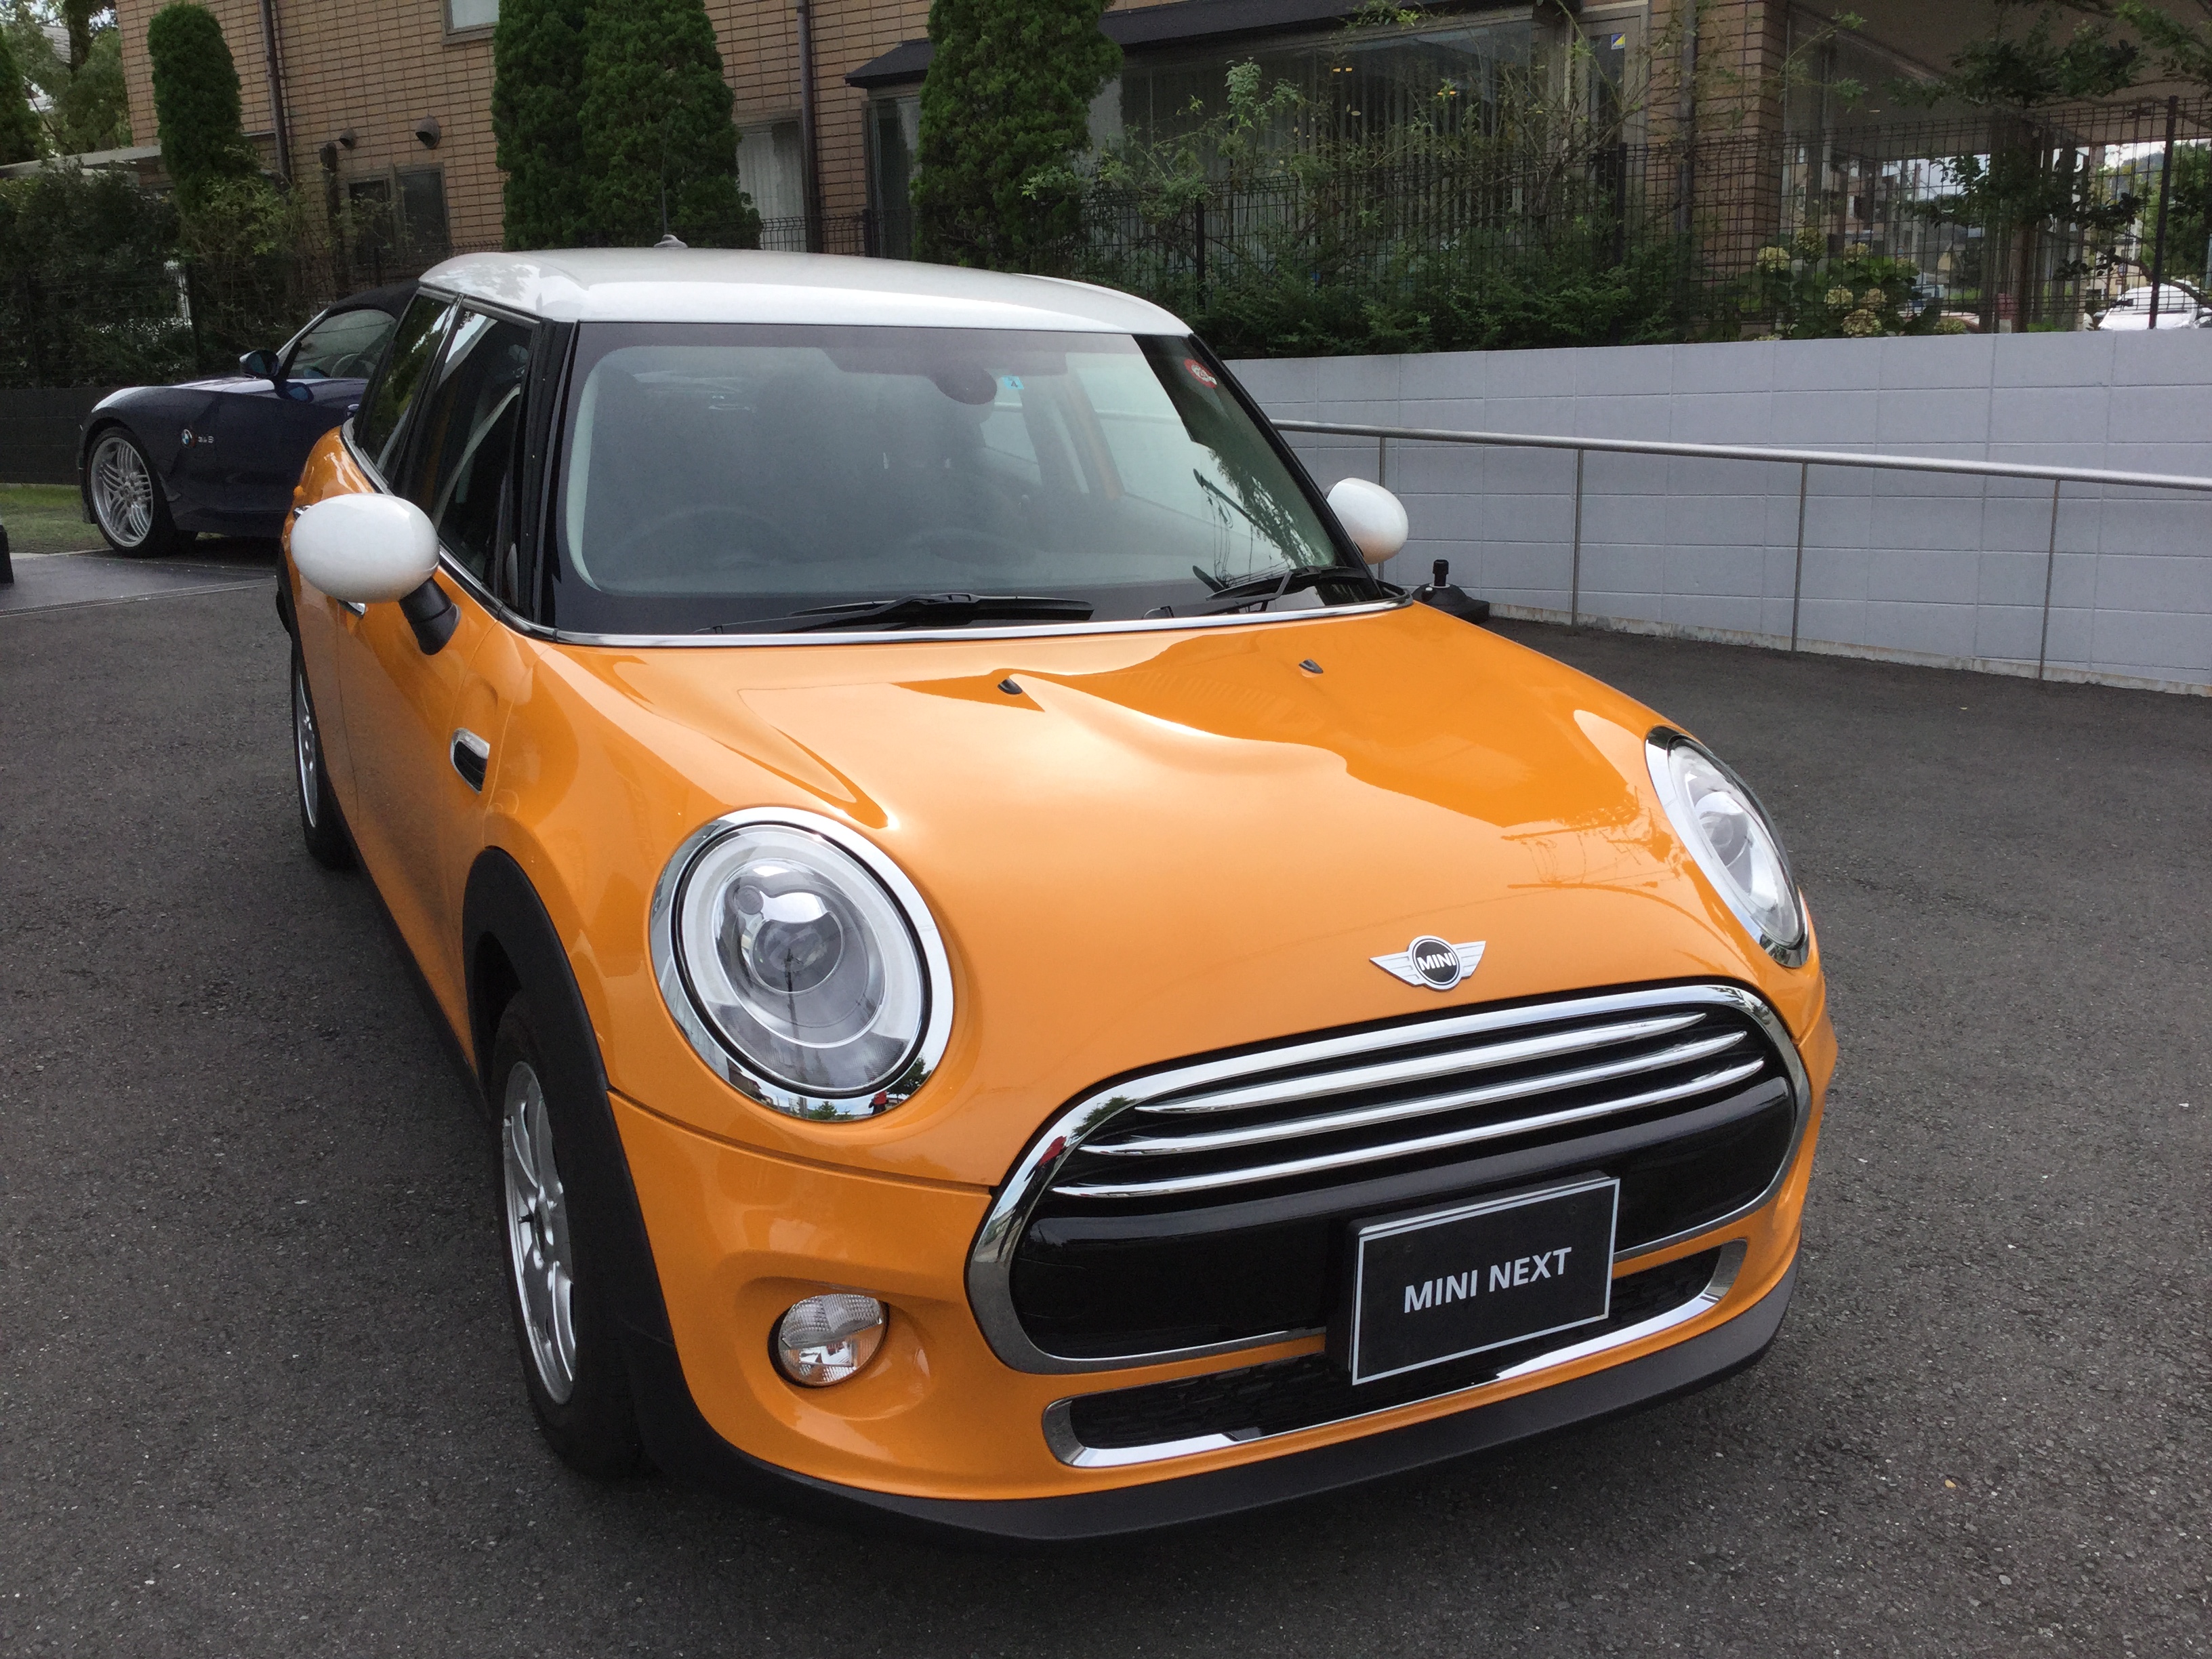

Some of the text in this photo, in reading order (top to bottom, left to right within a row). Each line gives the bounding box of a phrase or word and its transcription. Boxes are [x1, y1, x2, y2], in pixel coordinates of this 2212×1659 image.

[1417, 952, 1456, 970] MINI
[1404, 1247, 1572, 1313] MINI NEXT
